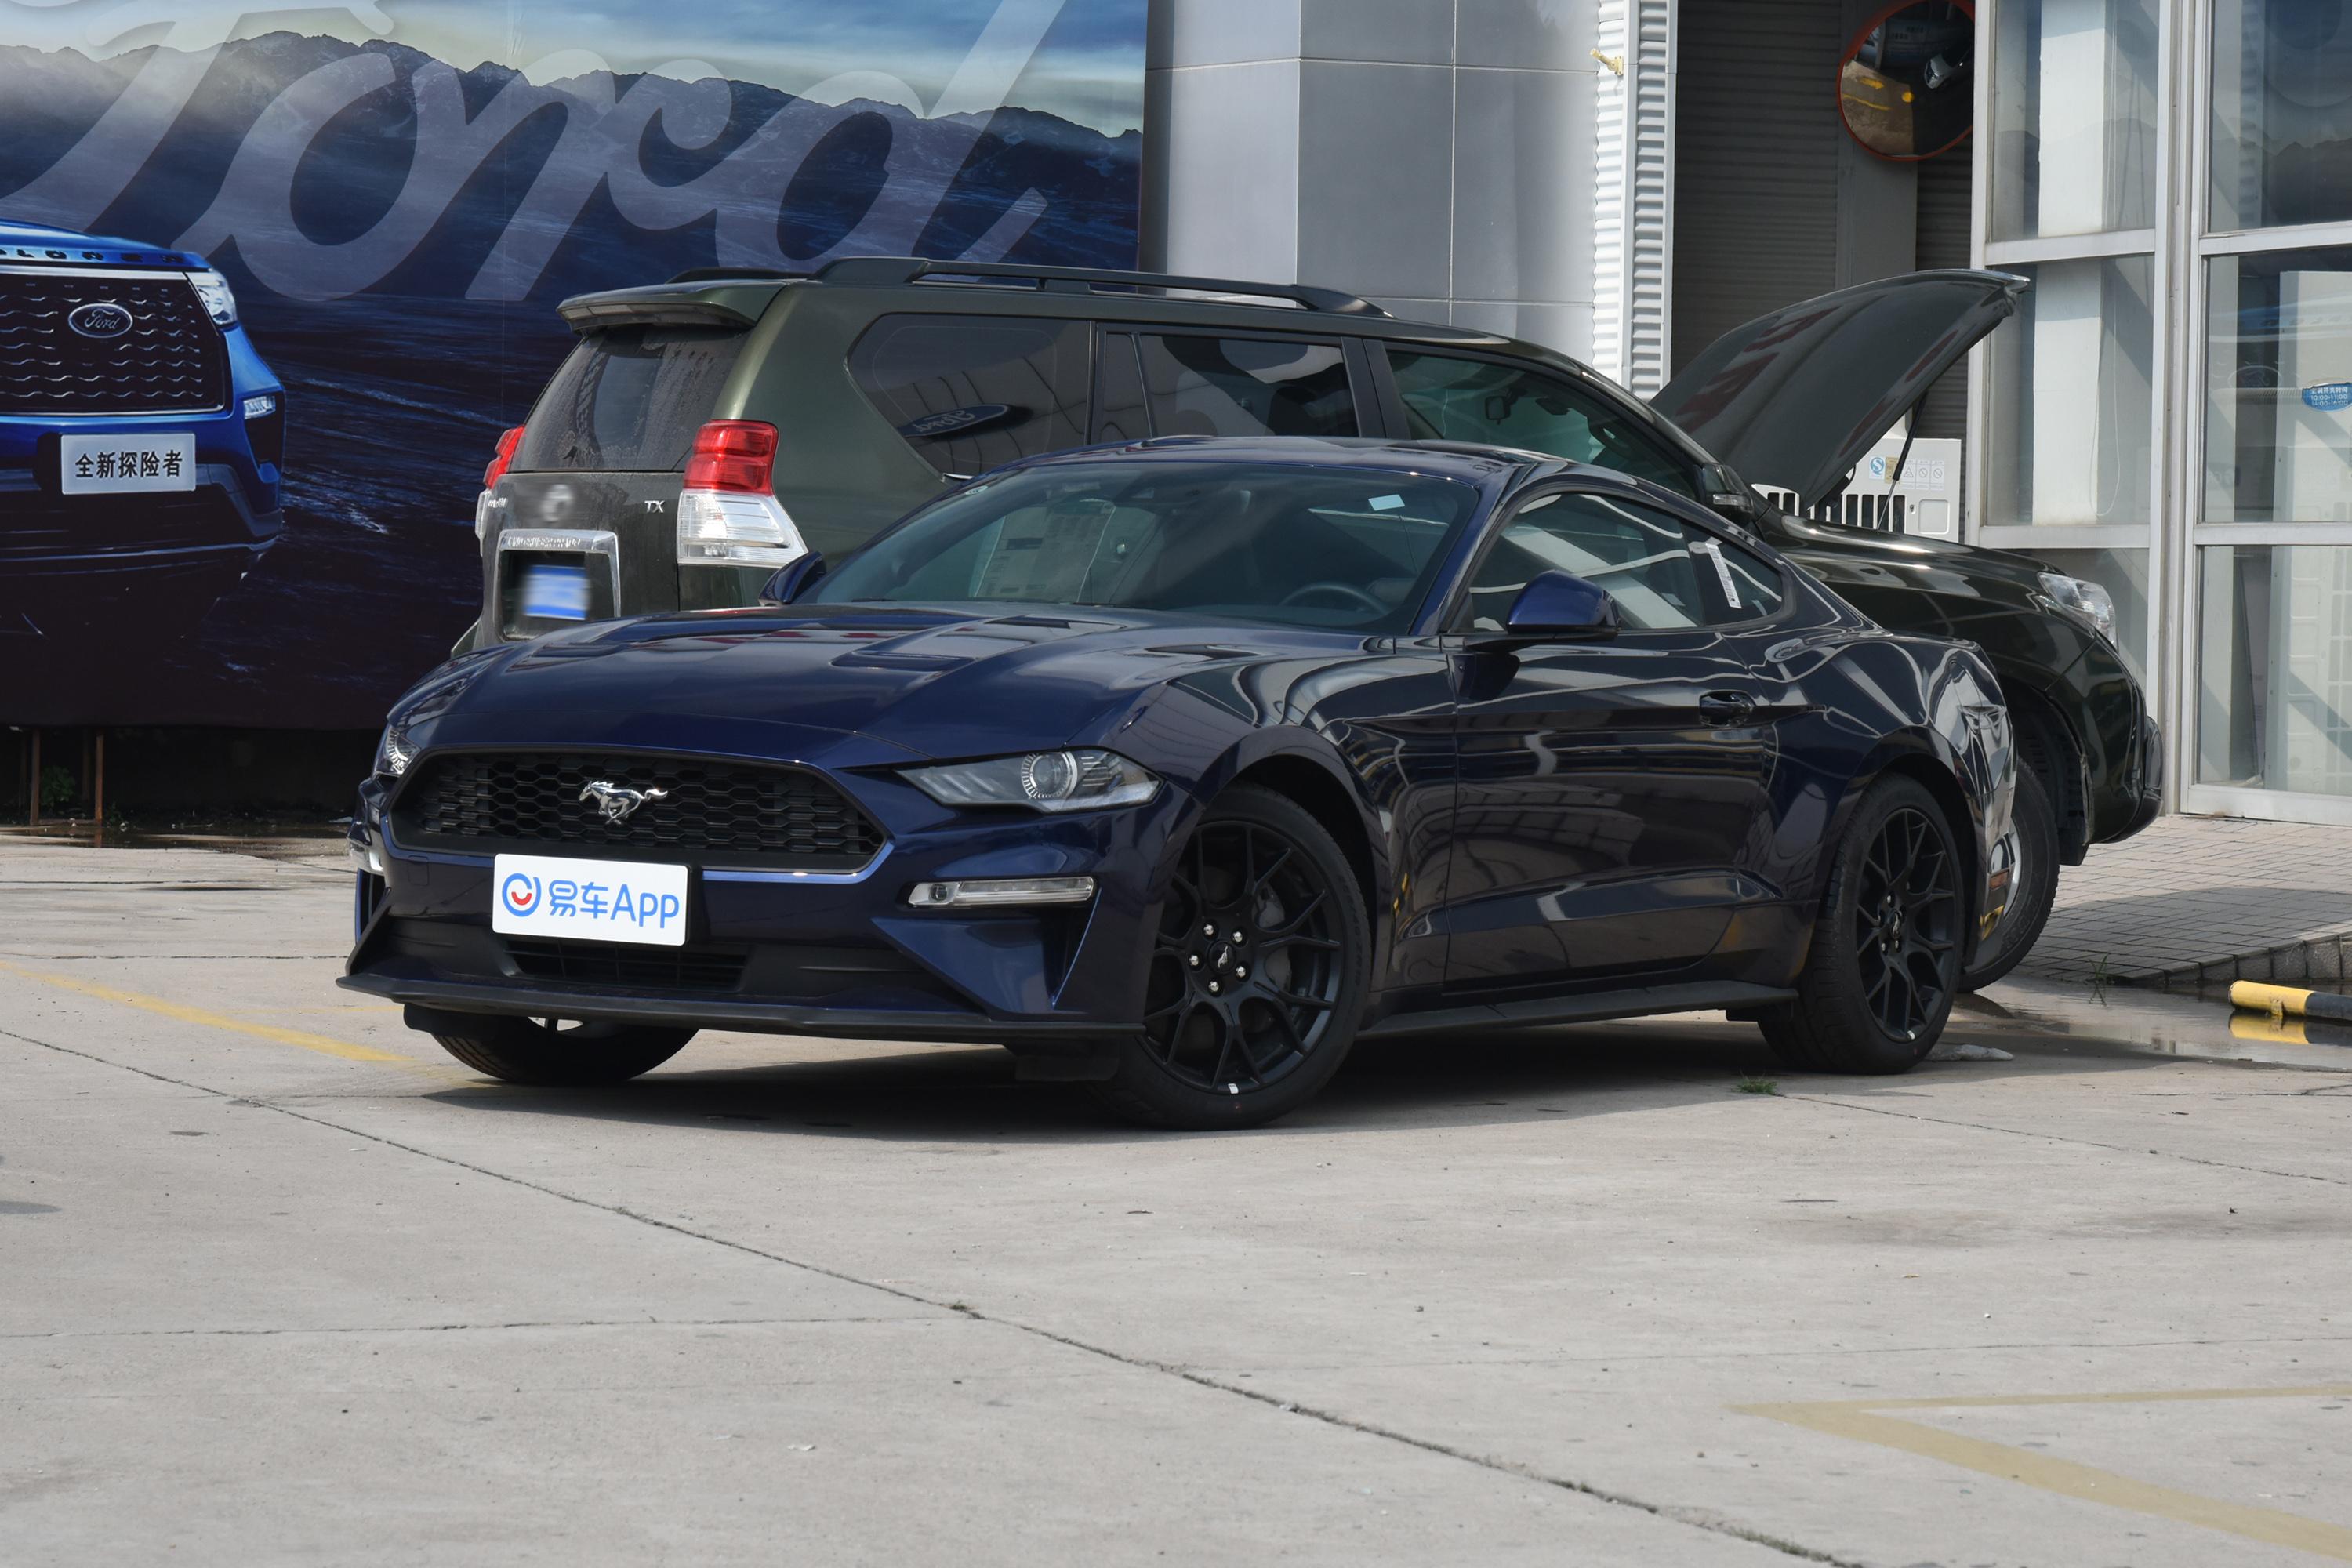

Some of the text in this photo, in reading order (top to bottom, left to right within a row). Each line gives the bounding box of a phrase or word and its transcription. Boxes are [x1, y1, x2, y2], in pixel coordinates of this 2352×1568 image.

[84, 308, 120, 329] Ford
[75, 449, 183, 478] 全新探险者
[644, 500, 666, 513] TX
[548, 880, 680, 929] 易车App
